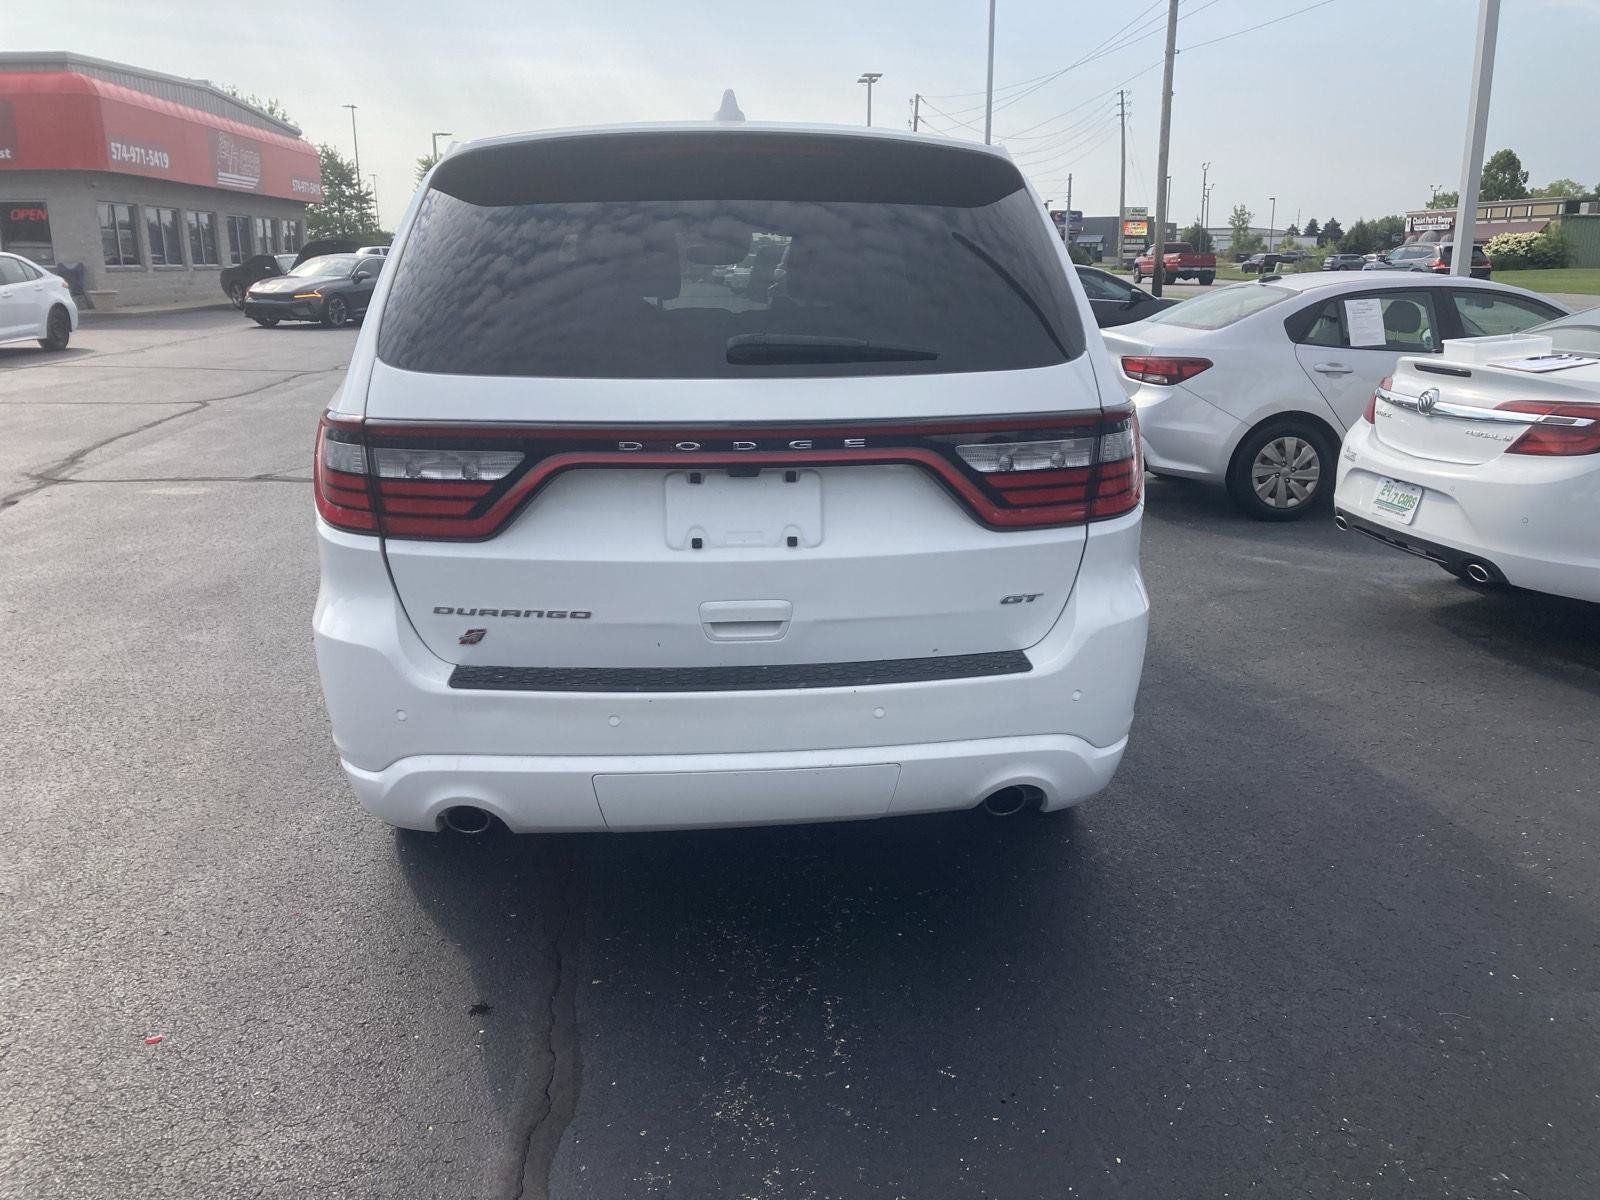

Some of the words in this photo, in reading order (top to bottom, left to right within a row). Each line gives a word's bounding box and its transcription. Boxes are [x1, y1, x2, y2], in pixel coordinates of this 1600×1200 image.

[110, 141, 169, 169] 574-971-5419
[9, 207, 48, 221] OPEN
[618, 438, 866, 451] DODGE
[1397, 493, 1418, 509] CARS
[1000, 592, 1045, 605] GT
[432, 606, 593, 620] DURANGO
